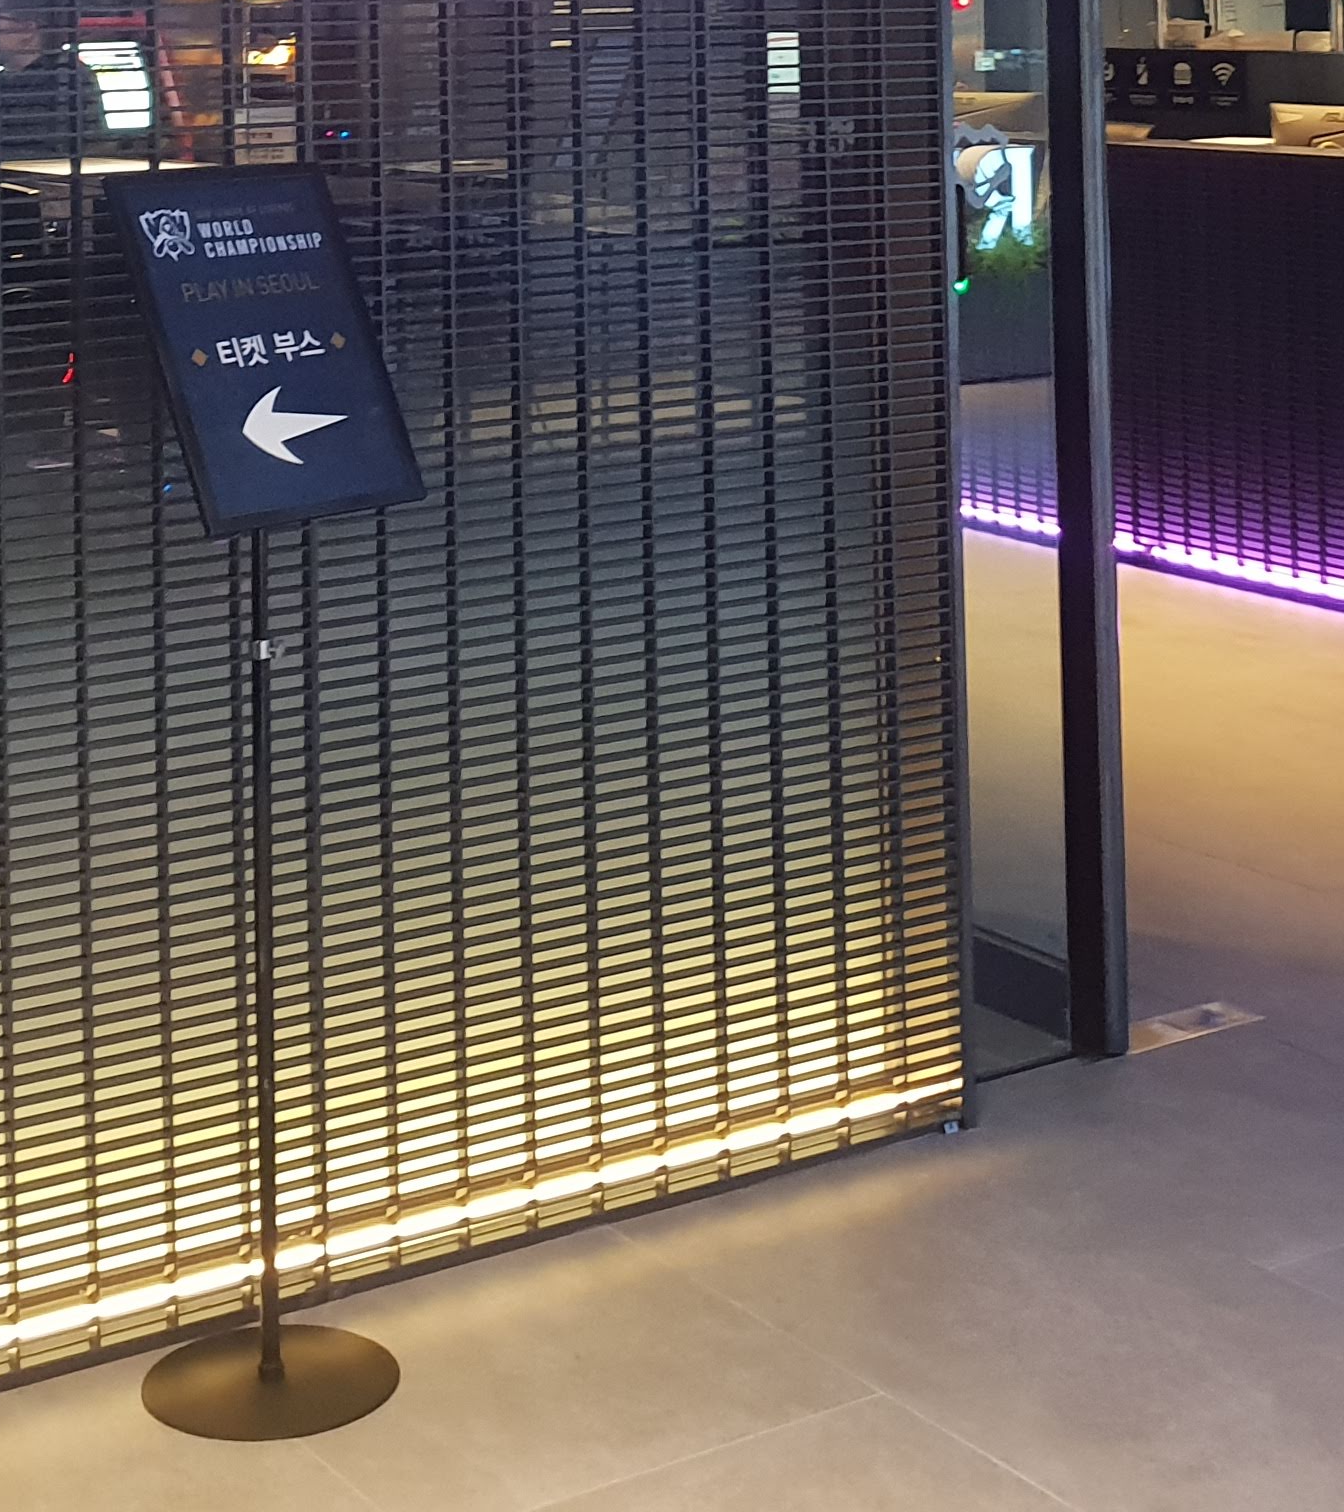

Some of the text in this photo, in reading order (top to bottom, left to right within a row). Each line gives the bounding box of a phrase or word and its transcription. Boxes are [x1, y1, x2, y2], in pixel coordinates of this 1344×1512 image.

[197, 219, 254, 238] WORLD
[204, 232, 322, 258] CHAMPIONSHIP
[181, 279, 227, 303] PLAY
[257, 271, 321, 296] SEOUL
[216, 329, 326, 368] 티켓 부스
